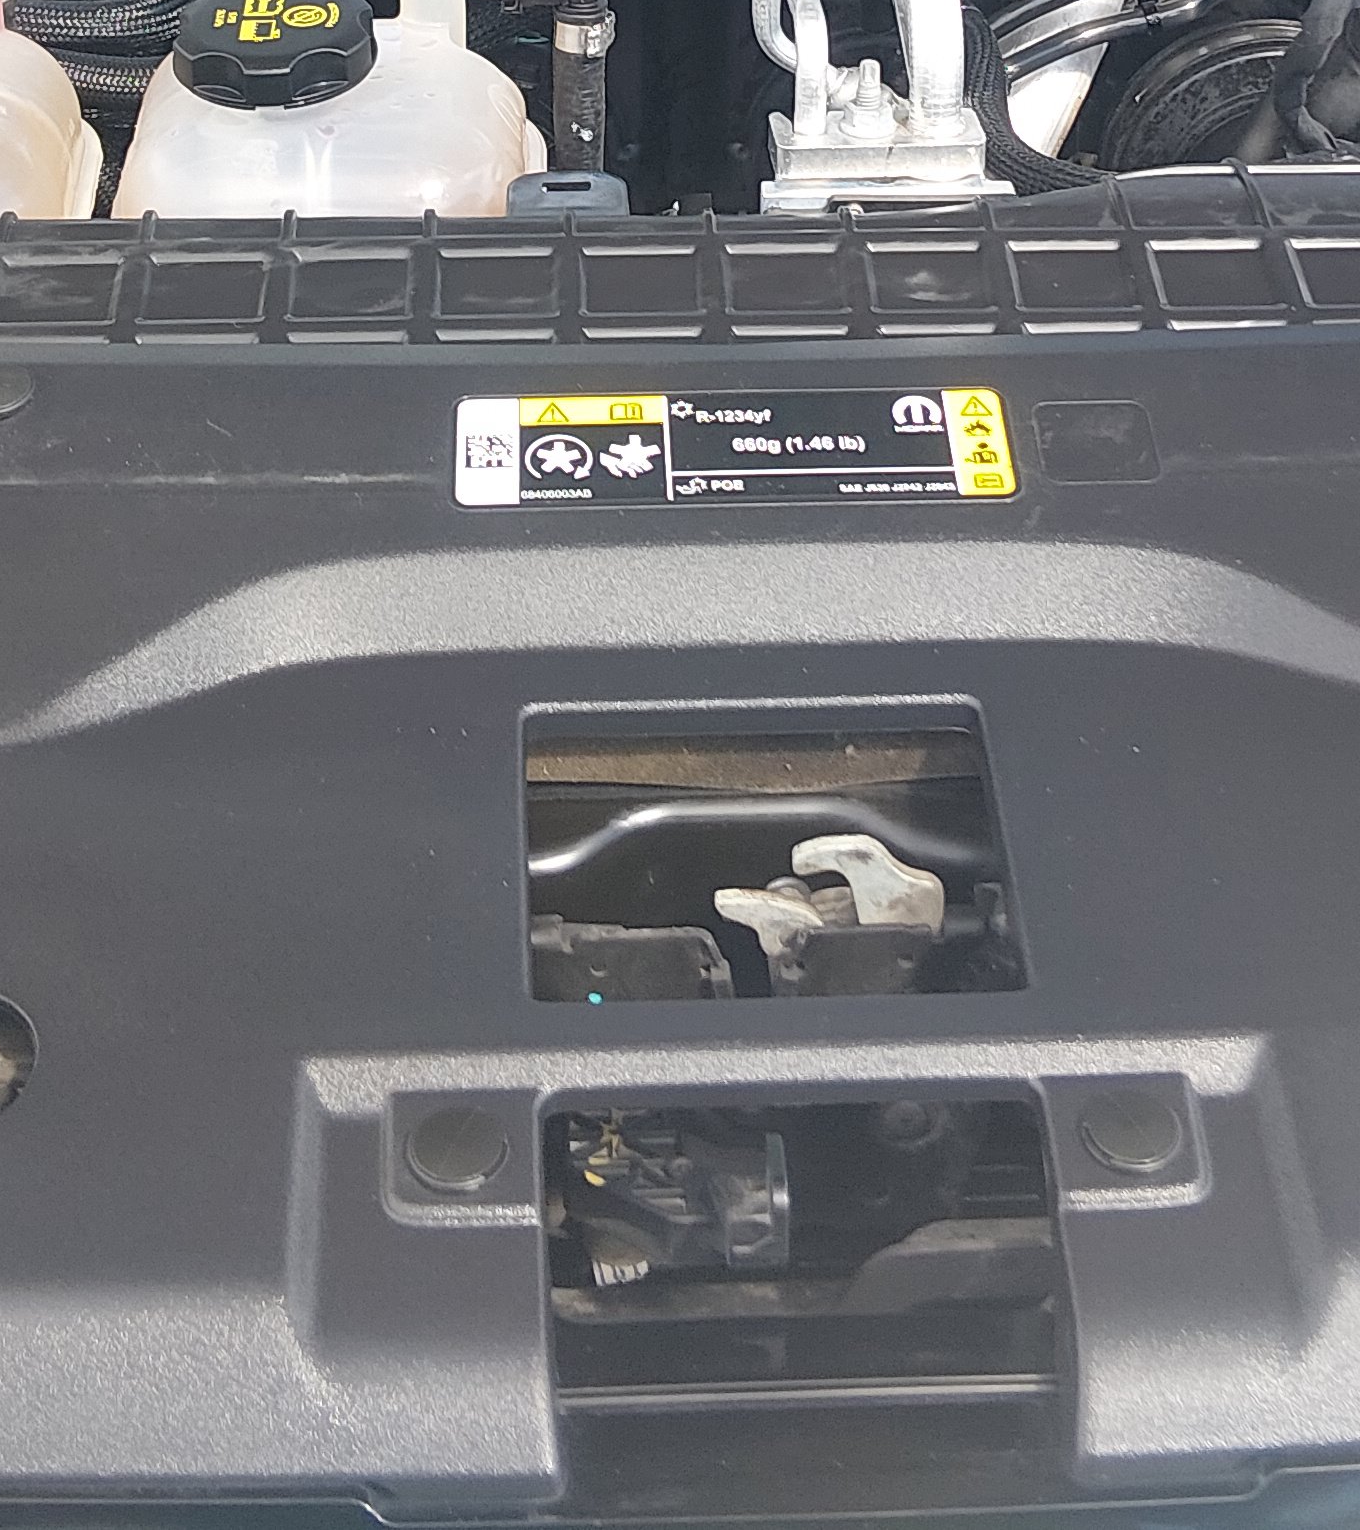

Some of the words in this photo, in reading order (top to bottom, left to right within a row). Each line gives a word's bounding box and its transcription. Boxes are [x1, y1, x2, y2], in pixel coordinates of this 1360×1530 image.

[695, 408, 771, 425] R-1234yf
[732, 436, 781, 454] 660g
[838, 434, 866, 453] lb)
